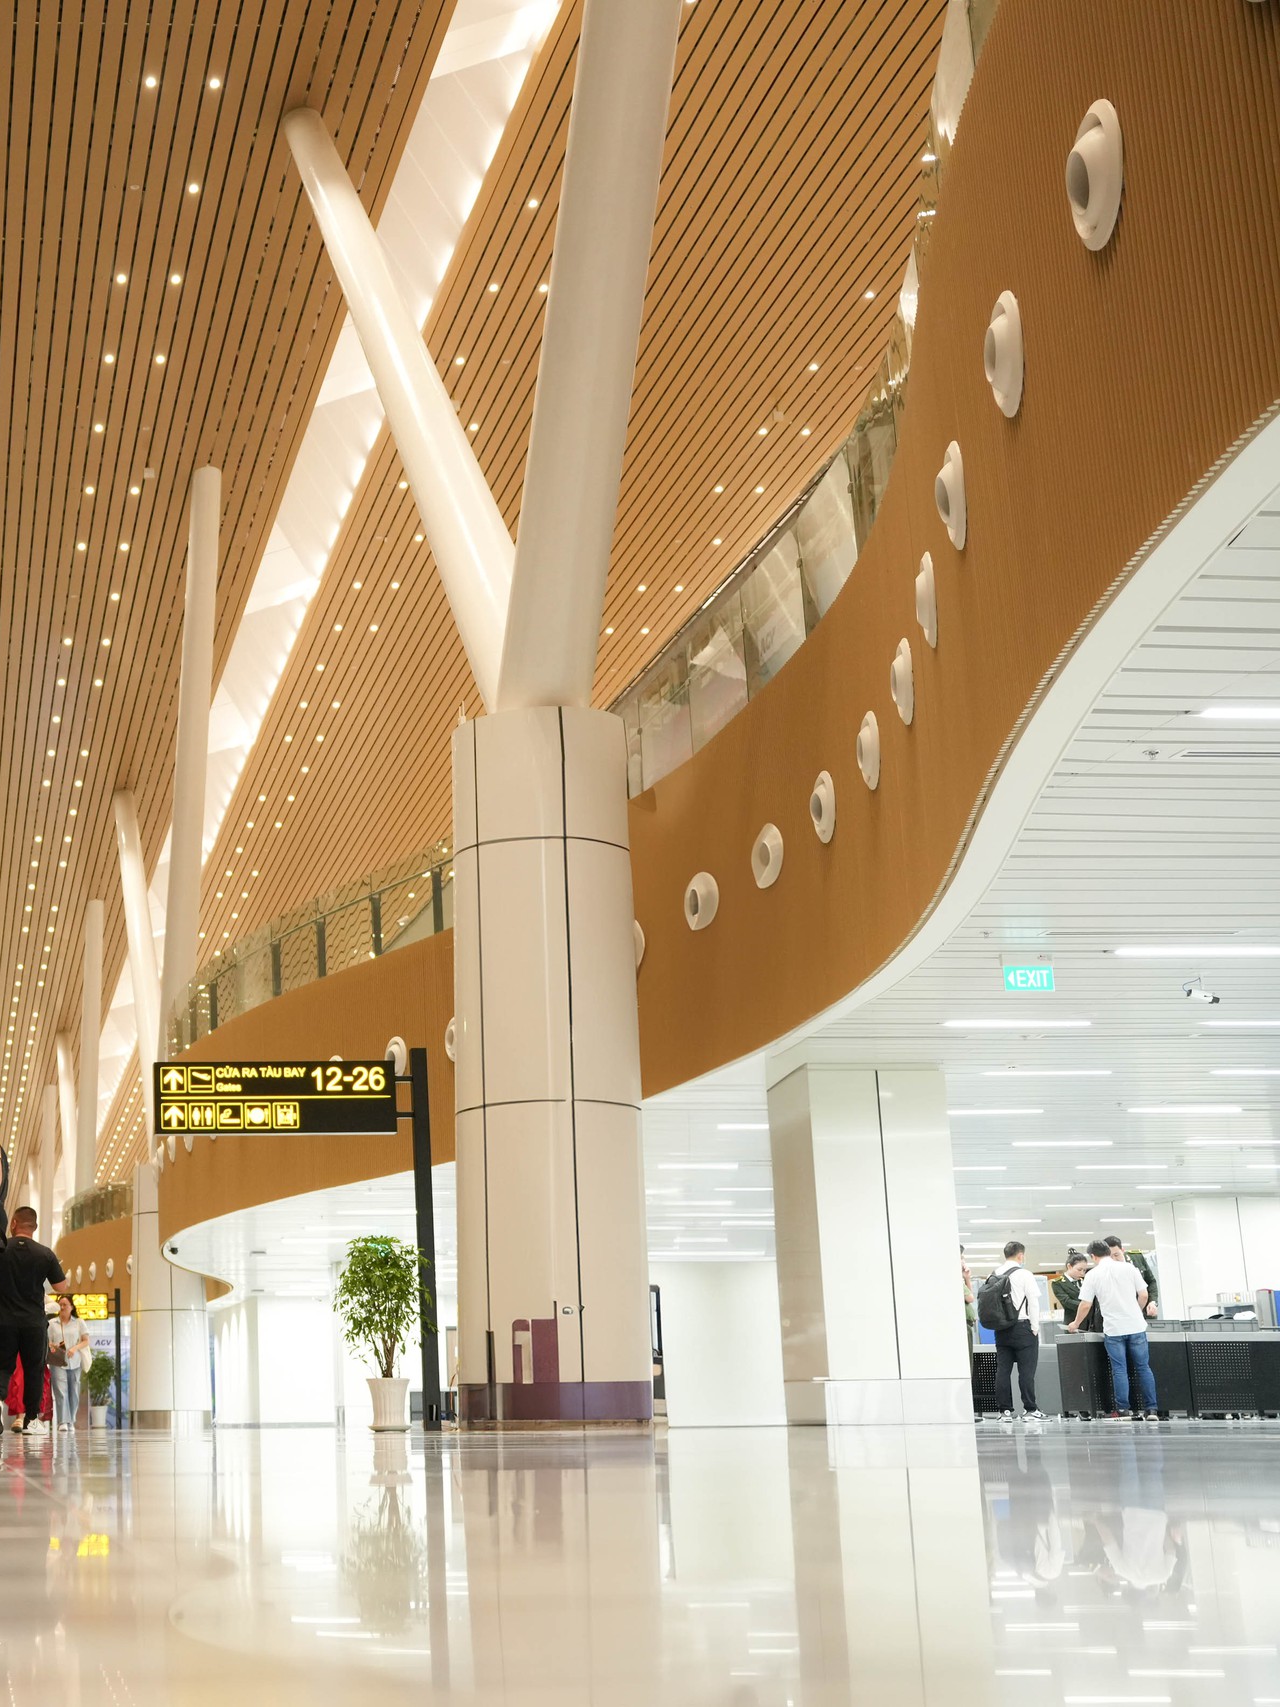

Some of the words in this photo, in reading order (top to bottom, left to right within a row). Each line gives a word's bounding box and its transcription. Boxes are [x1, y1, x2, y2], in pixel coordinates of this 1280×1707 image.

[1016, 970, 1049, 987] EXIT
[241, 1067, 258, 1078] RA
[259, 1065, 282, 1078] TÀU
[283, 1068, 306, 1078] BAY
[311, 1066, 385, 1091] 12-26
[215, 1082, 242, 1093] Gates
